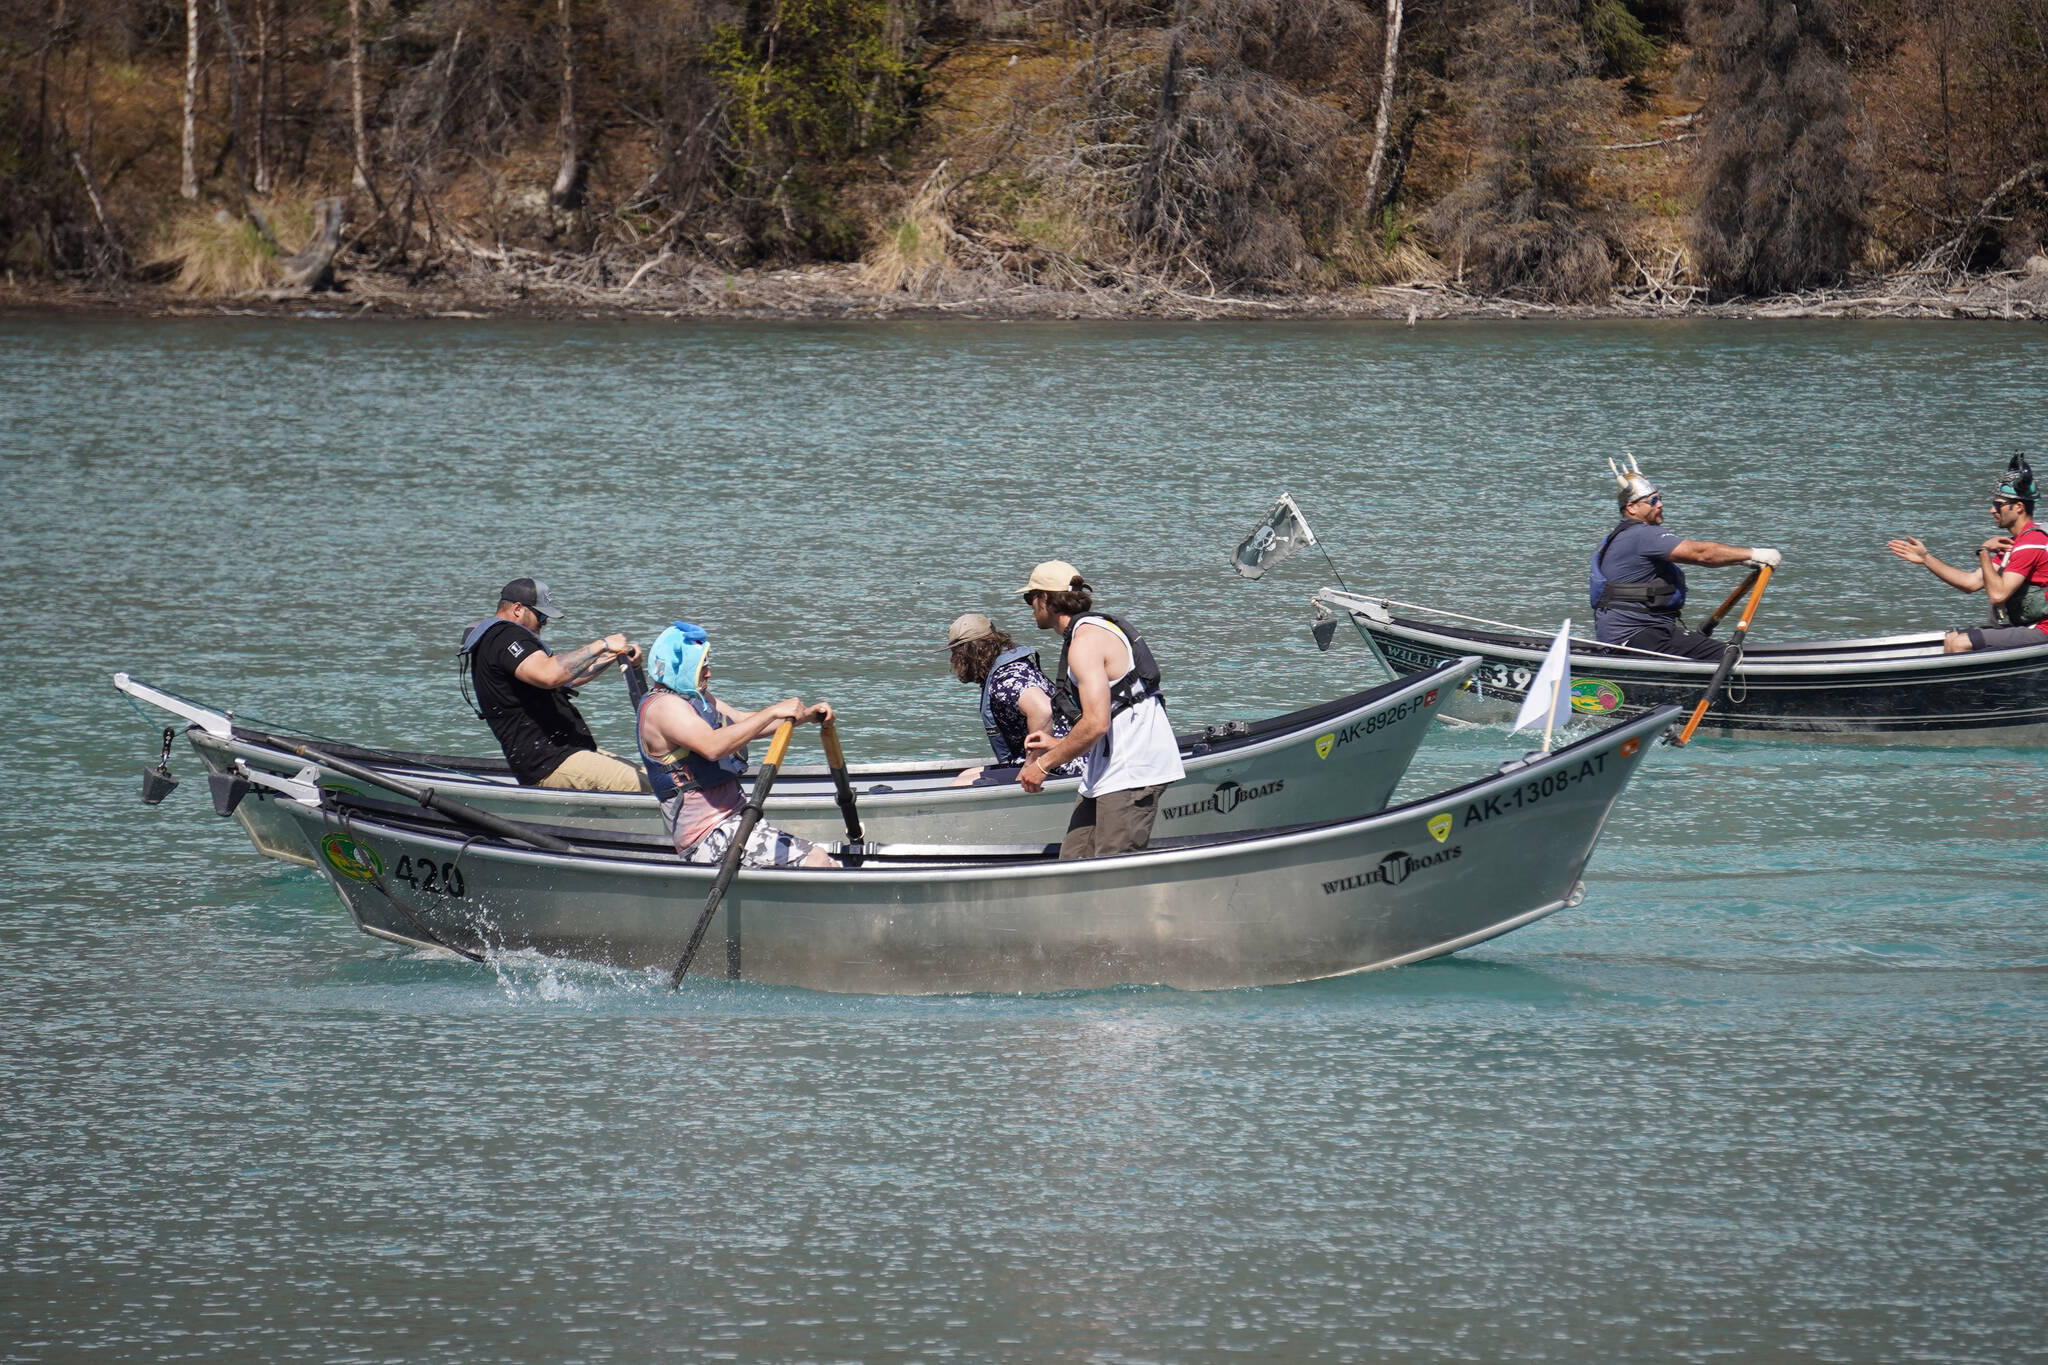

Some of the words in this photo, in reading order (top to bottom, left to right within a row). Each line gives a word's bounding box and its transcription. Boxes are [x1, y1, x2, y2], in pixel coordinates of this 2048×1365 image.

[1336, 695, 1425, 747] AK-8926-P
[1161, 797, 1215, 821] WILLIE
[1239, 779, 1285, 803] BOATS
[1463, 751, 1610, 828] AK-1308-AT
[394, 854, 465, 898] 420
[1321, 869, 1384, 895] WILLIE
[1409, 845, 1462, 872] BOATS
